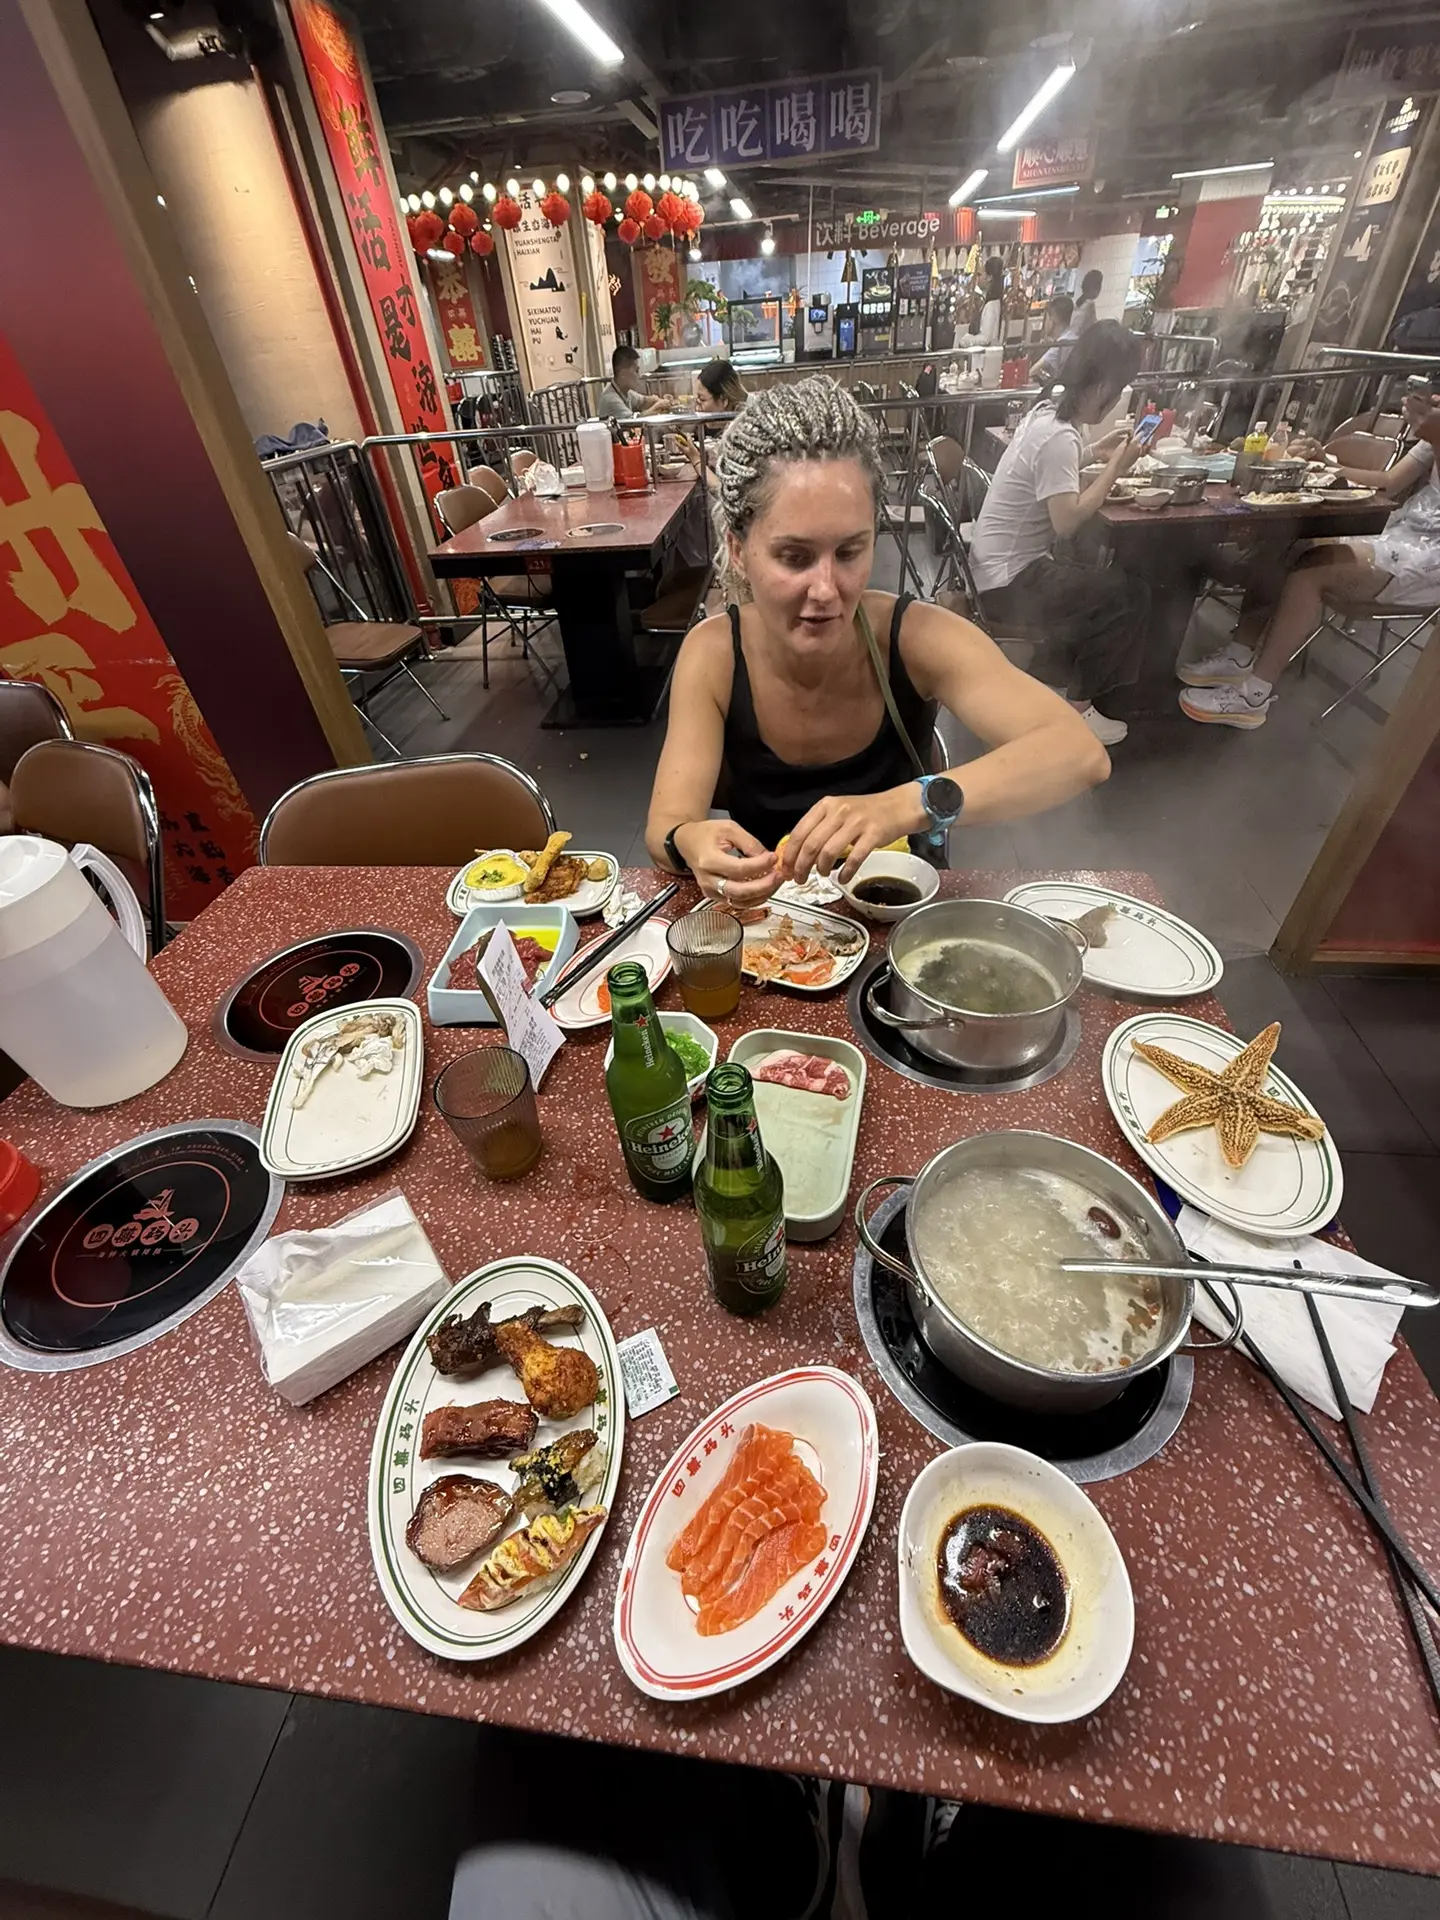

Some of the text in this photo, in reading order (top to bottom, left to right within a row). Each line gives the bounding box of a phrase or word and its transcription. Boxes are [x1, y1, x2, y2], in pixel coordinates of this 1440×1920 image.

[668, 82, 871, 163] 吃吃喝喝
[816, 221, 852, 246] 饮料
[858, 218, 940, 240] Beverage
[516, 248, 541, 256] HAIXIAN
[335, 91, 460, 540] 鲜活才是济世良
[527, 306, 562, 316] SIXIMATOU
[528, 317, 560, 325] YUCHUAN
[641, 1029, 655, 1068] Heineken
